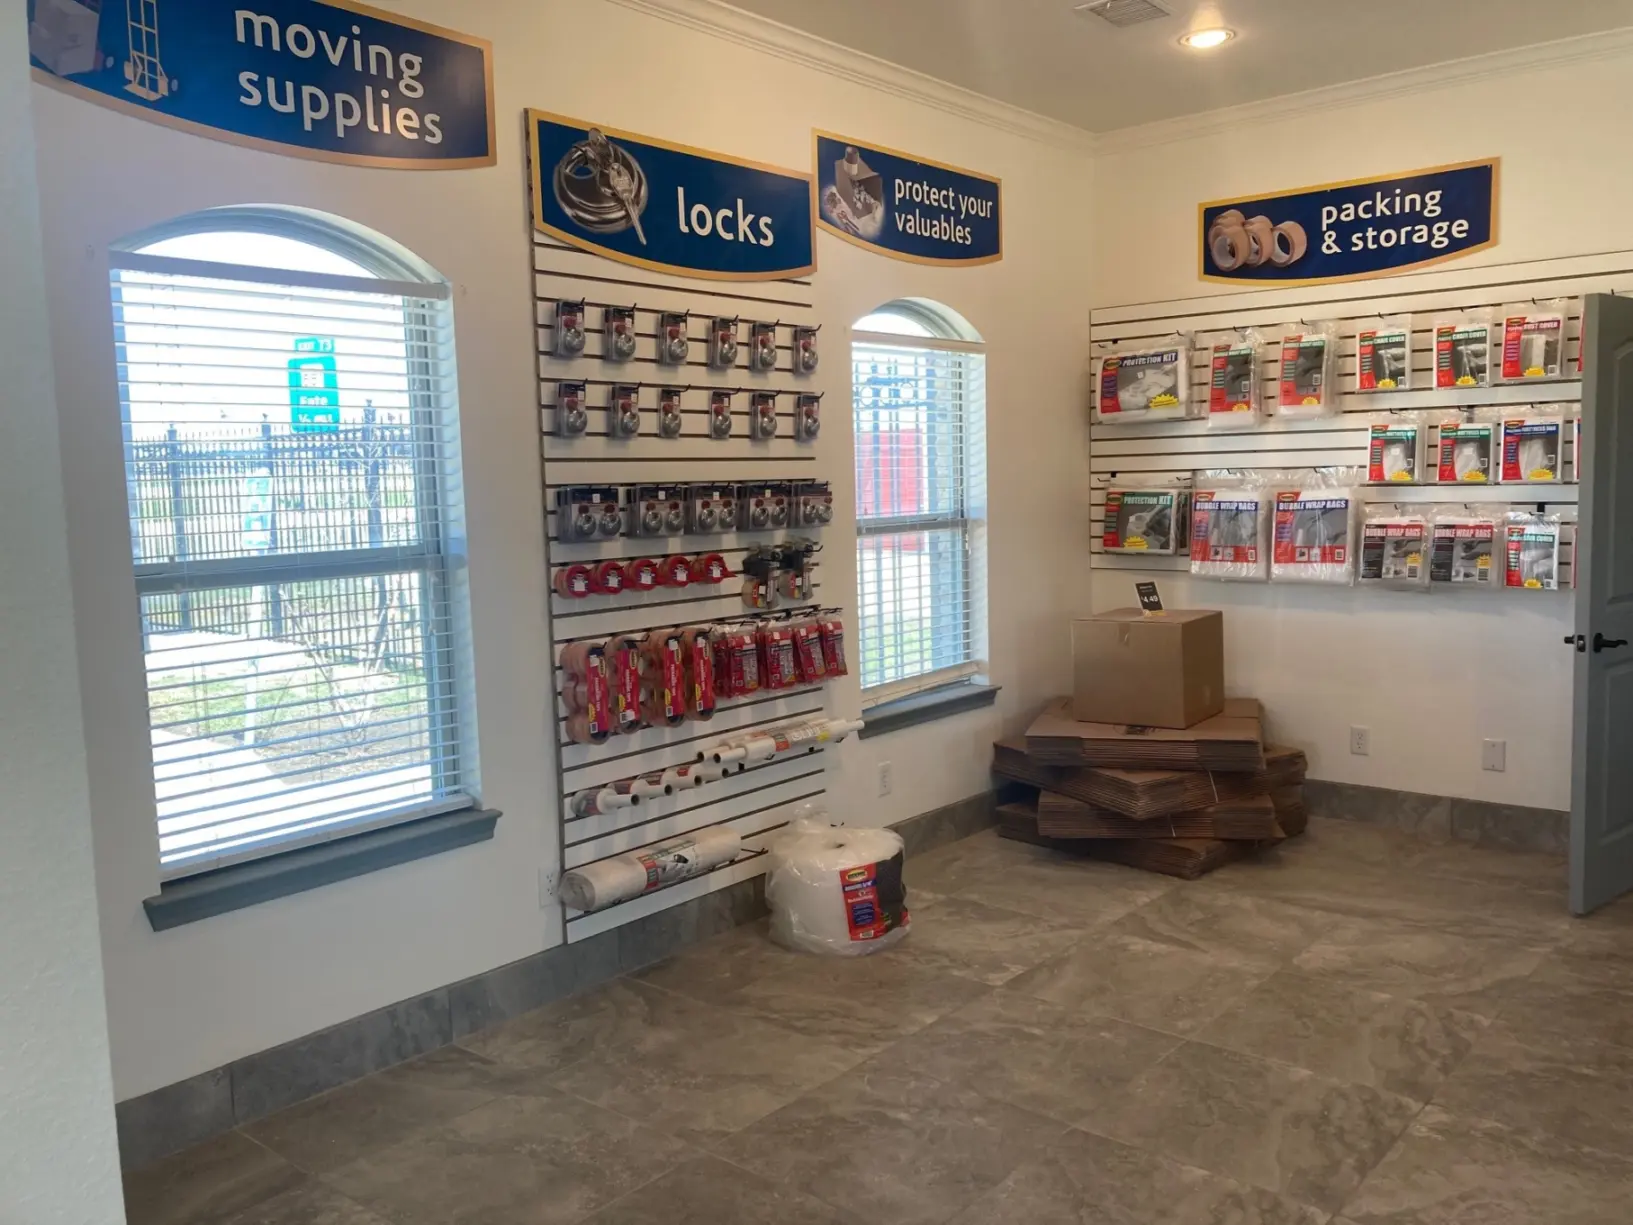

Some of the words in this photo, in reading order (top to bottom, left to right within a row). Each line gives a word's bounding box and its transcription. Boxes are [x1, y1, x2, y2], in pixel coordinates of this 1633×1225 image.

[235, 10, 424, 99] moving
[238, 71, 443, 145] supplies
[677, 187, 775, 247] locks
[894, 178, 956, 211] protect
[958, 194, 993, 219] your
[1321, 188, 1442, 231] packing
[894, 208, 972, 246] valuables
[1321, 230, 1342, 255] &
[1351, 219, 1469, 252] storage
[1122, 356, 1162, 367] PROTECTION
[1163, 353, 1176, 362] KIT
[1124, 496, 1158, 505] PROTECTION
[1158, 495, 1173, 505] KIT
[1220, 502, 1238, 510] WRAP
[1305, 501, 1326, 510] WRAP
[1326, 500, 1346, 509] BAGS
